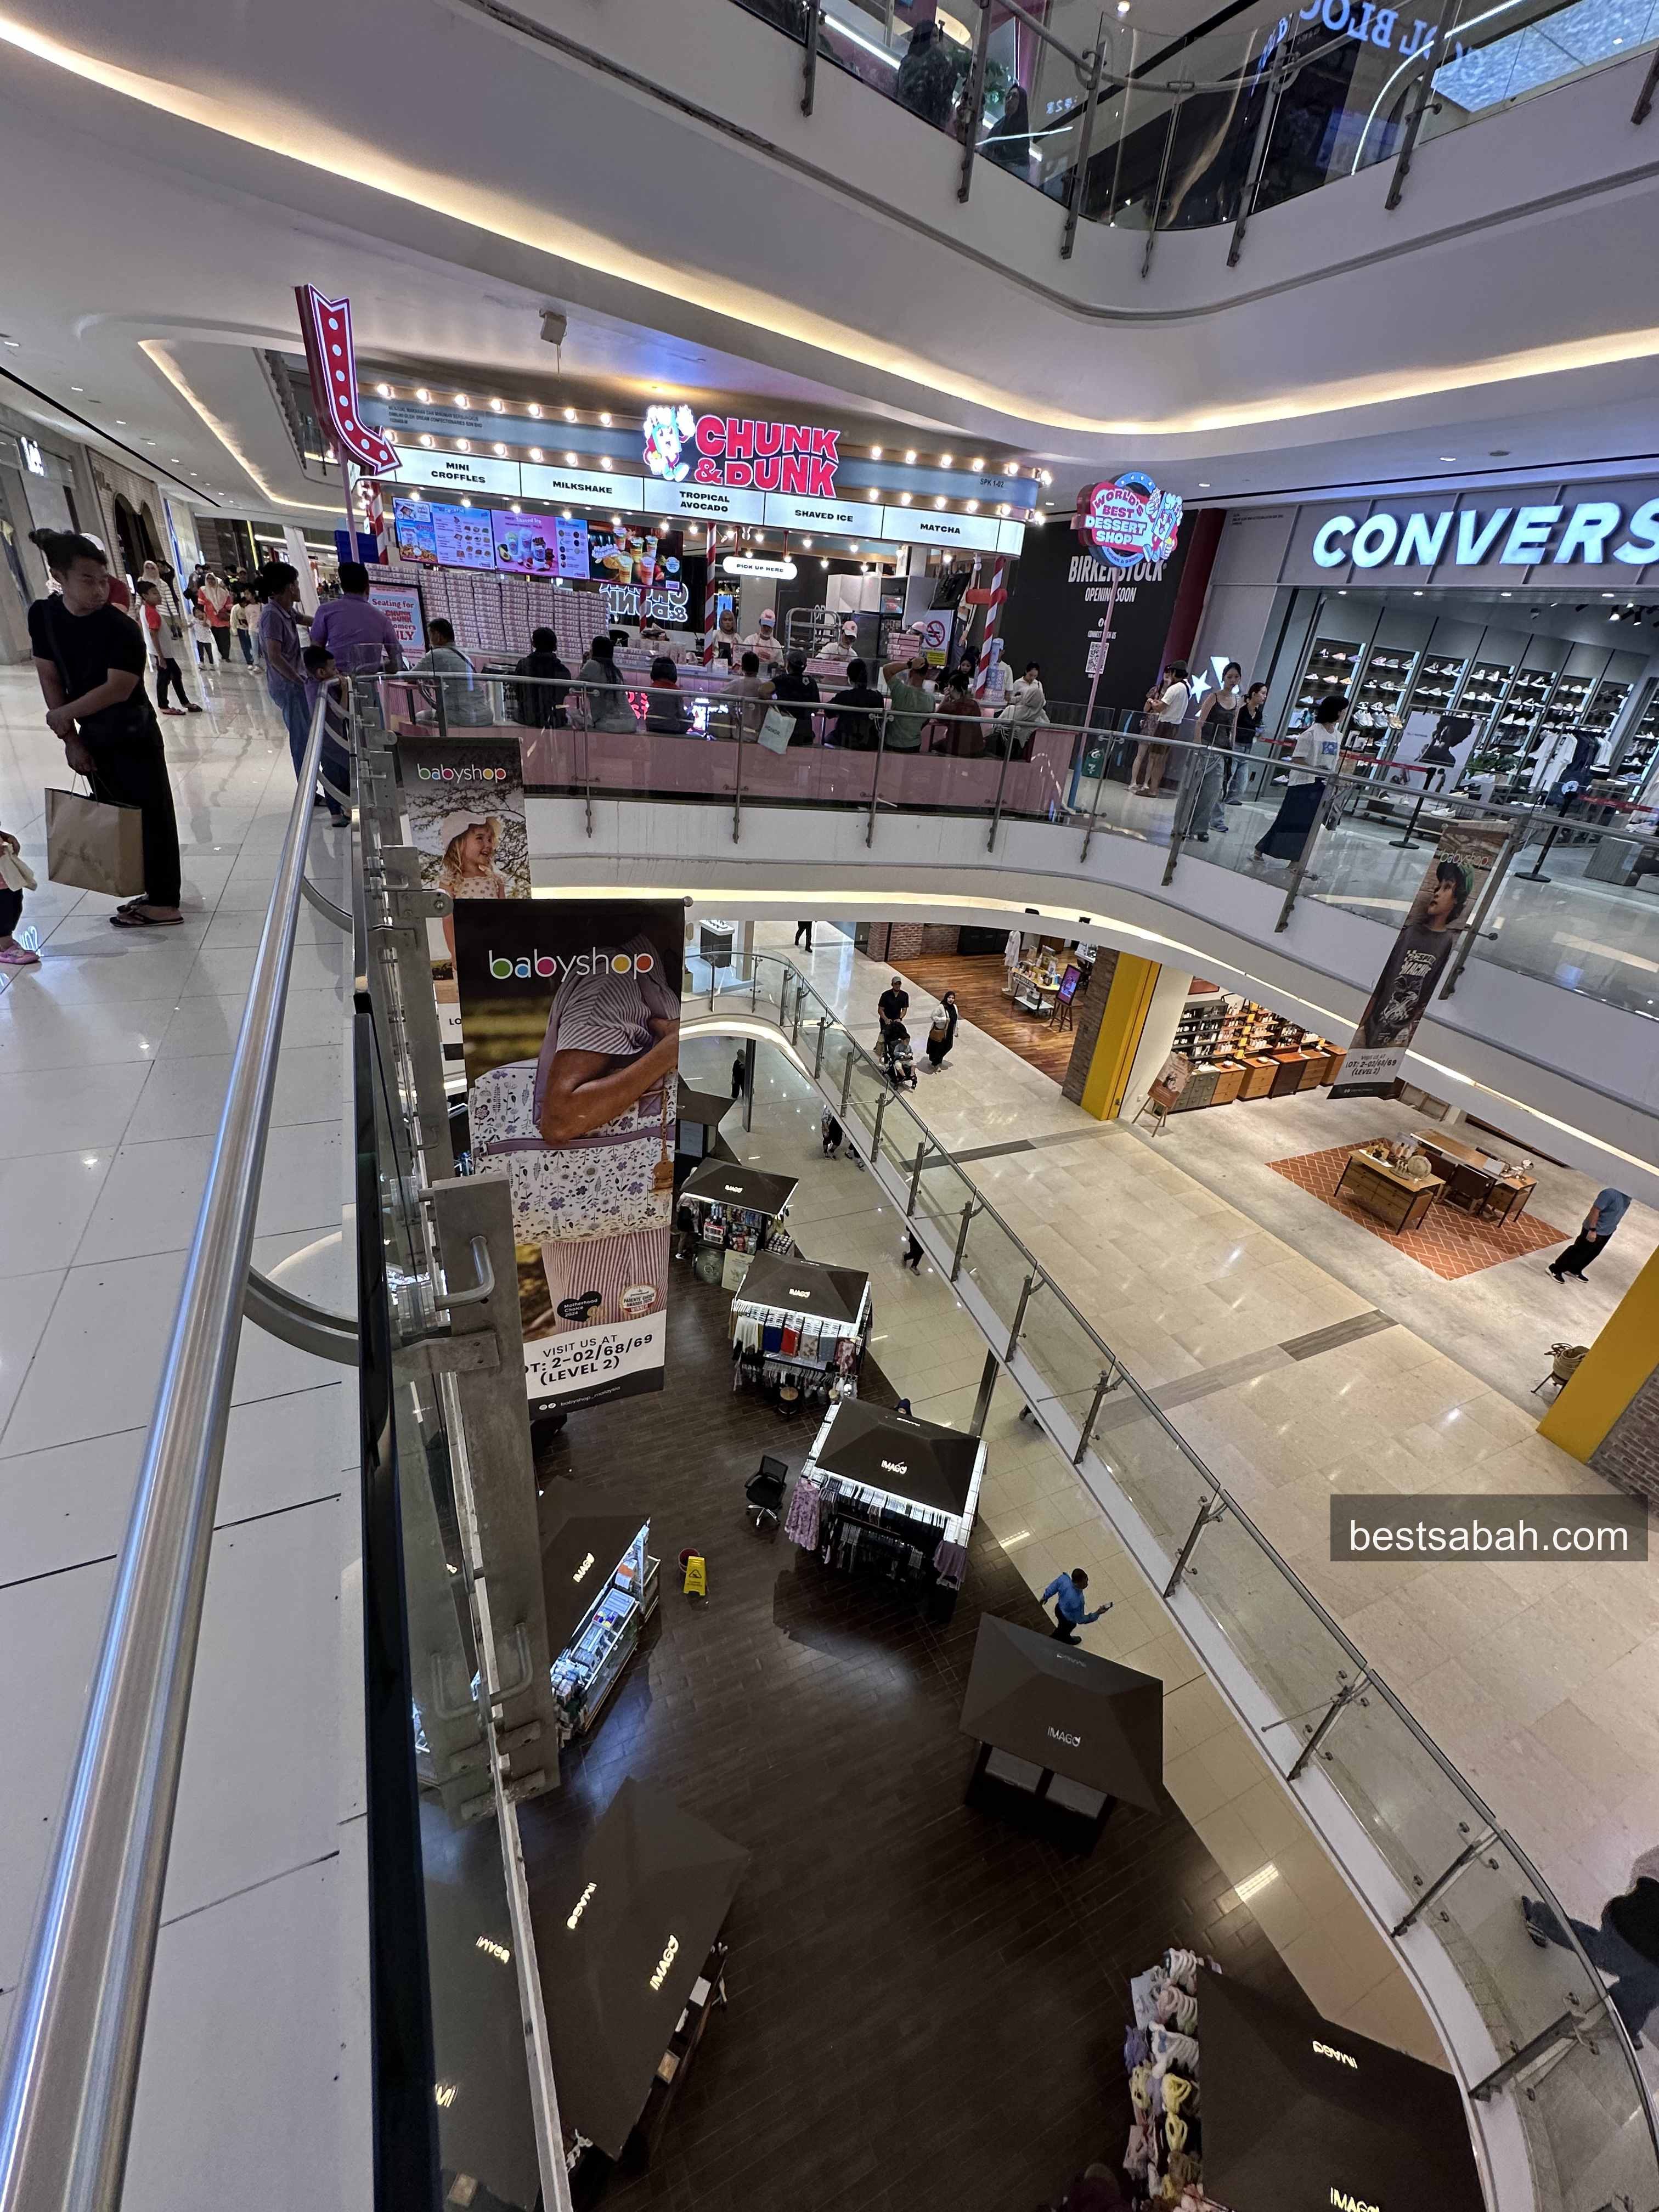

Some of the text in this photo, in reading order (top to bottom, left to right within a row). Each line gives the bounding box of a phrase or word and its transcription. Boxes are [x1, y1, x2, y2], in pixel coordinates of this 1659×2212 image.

[695, 415, 840, 466] CHUNK
[445, 462, 470, 472] MINI
[431, 471, 486, 484] CROFFLES
[552, 481, 612, 494] MILKSHAKE
[680, 492, 730, 503] TROPICAL
[1092, 488, 1144, 517] WORLD'S
[680, 501, 728, 512] AVOCADO
[1102, 505, 1135, 518] BEST
[794, 510, 853, 522] SHAVED ICE
[920, 523, 961, 534] MATCHA
[1085, 516, 1148, 535] DESSERT
[1312, 497, 1659, 568] CONVERS
[1096, 531, 1133, 545] SHOP
[1085, 587, 1137, 602] OPENIN SOON
[372, 599, 402, 610] Seating
[417, 764, 506, 785] babyshop
[1440, 850, 1488, 867] babyshop
[488, 947, 654, 982] babyshop
[1352, 1067, 1372, 1076] (LEVEL
[564, 1298, 598, 1308] Motherhood
[543, 1334, 618, 1357] VISIT US AT
[552, 1334, 653, 1369] 2-02/68/69
[540, 1355, 620, 1386] (LEVEL 2)
[560, 1385, 622, 1407] babyshop_malaysia
[881, 1459, 907, 1475] IMAGO
[572, 1551, 595, 1584] IMAGO
[1047, 1725, 1082, 1747] IMAGO
[648, 1934, 681, 1991] IMAGO
[1330, 2186, 1380, 2212] IMAG
